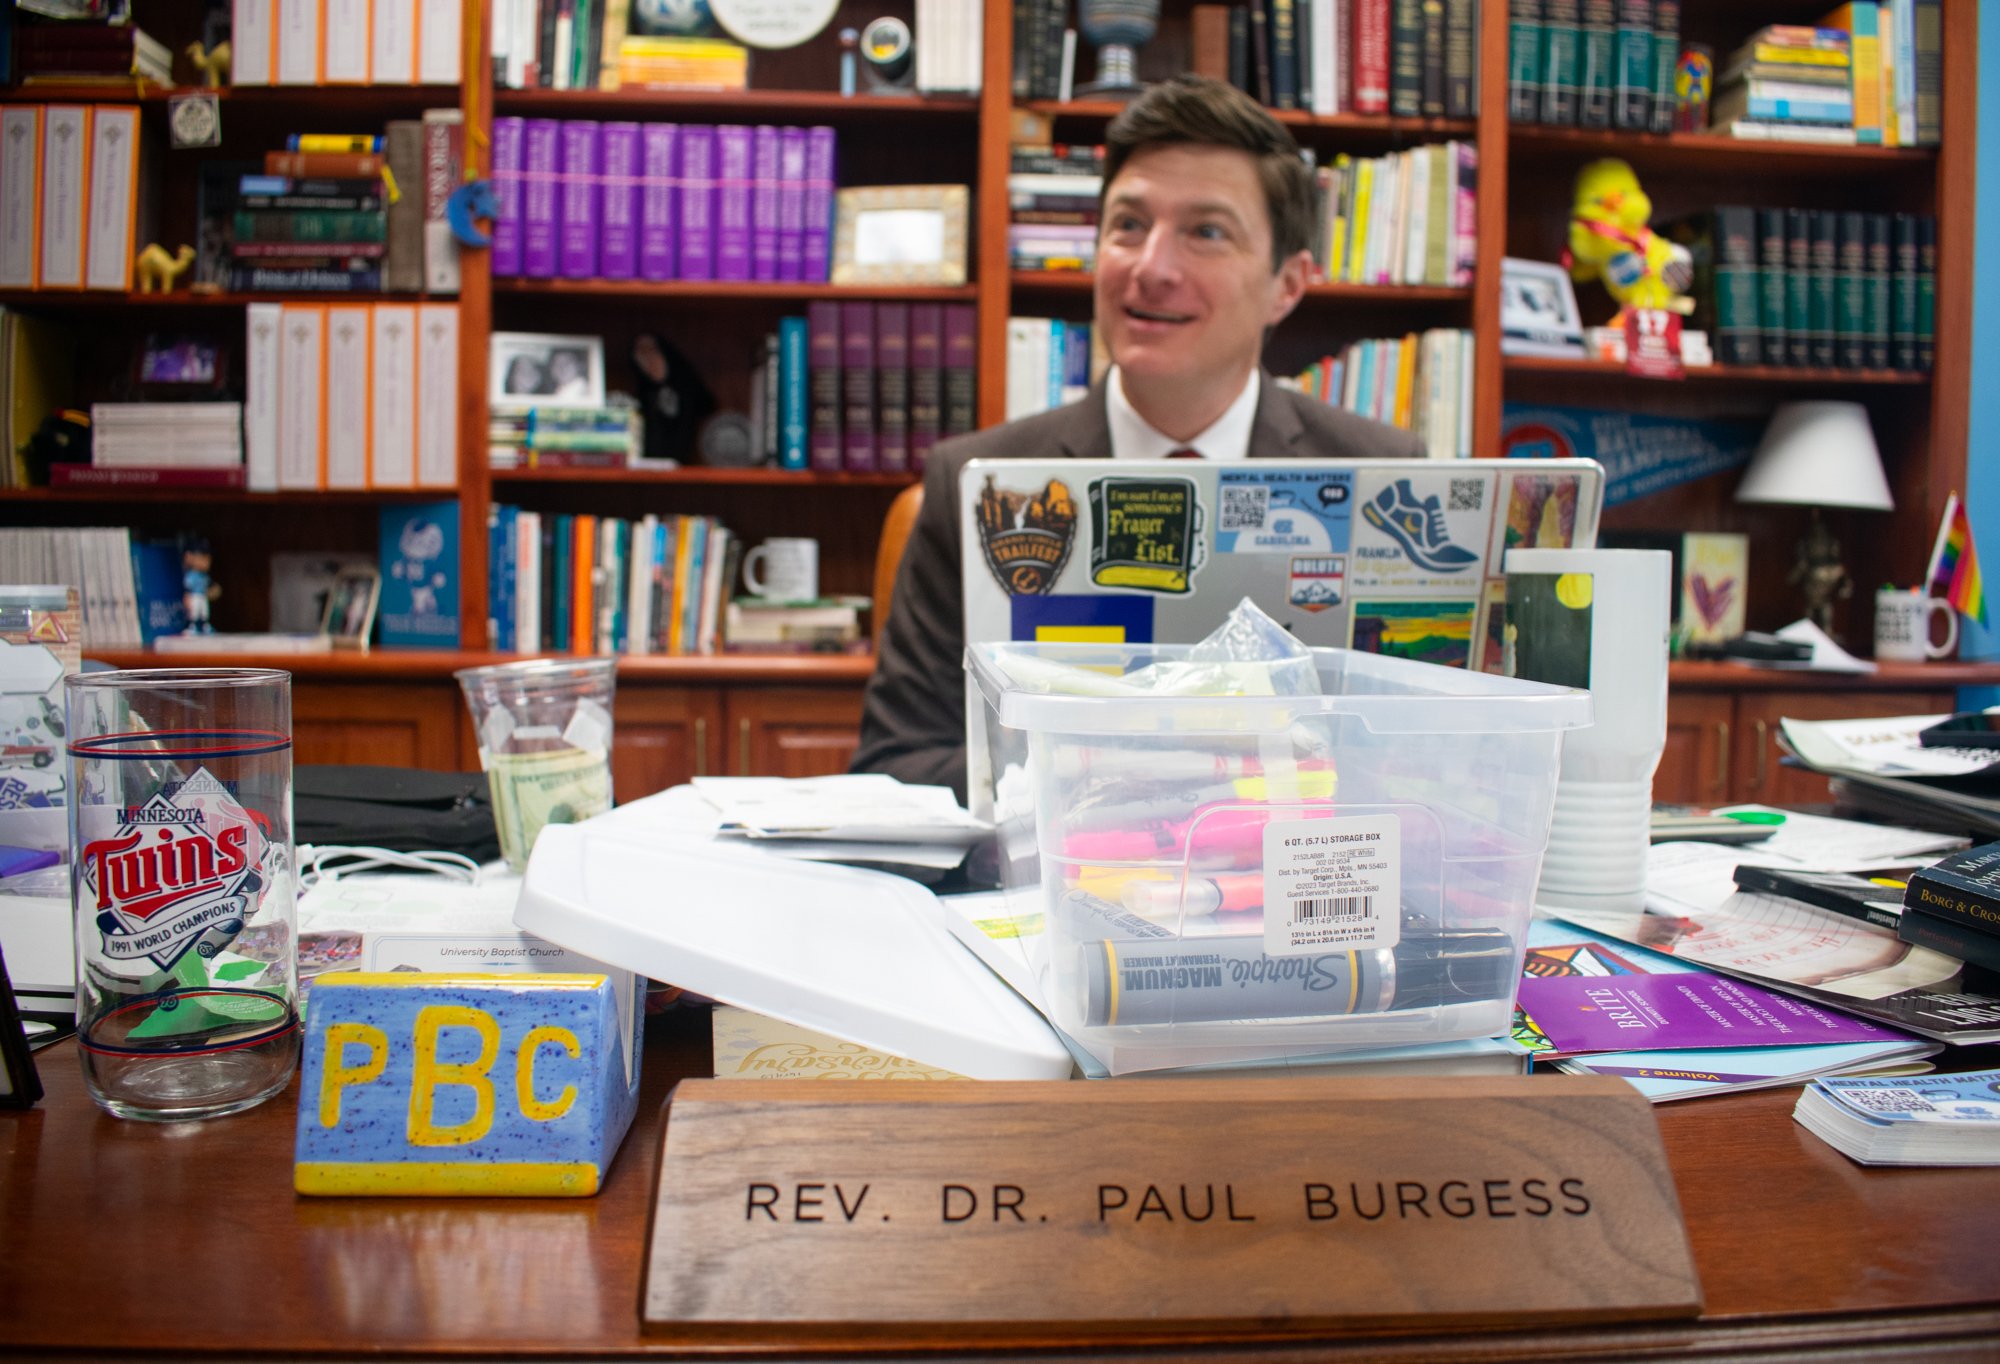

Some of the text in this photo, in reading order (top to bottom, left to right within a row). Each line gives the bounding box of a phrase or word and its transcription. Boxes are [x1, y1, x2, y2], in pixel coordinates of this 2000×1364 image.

[1222, 473, 1351, 481] MENTAL HEALTH MATTERS
[1322, 488, 1344, 496] 988
[1109, 509, 1165, 539] Prayer
[1255, 536, 1311, 545] CAROLINA
[993, 543, 1061, 563] TRAILFEST
[1135, 539, 1180, 563] List.
[1356, 547, 1402, 559] FRANKLIN
[116, 808, 205, 824] MINNESOTA
[1284, 839, 1290, 847] 6
[1291, 838, 1304, 846] QT.
[1305, 837, 1320, 846] (5.7
[1321, 837, 1329, 845] L)
[1330, 834, 1364, 844] STORAGE
[84, 825, 248, 911] Twins
[1292, 868, 1301, 876] by
[1301, 866, 1320, 875] Target
[1313, 873, 1333, 881] Origin:
[1304, 888, 1330, 897] Services
[1331, 885, 1380, 895] 1-800-440-0680
[1318, 880, 1336, 889] Target
[1956, 900, 1966, 913] &
[1303, 917, 1332, 925] 73149
[1334, 915, 1363, 924] 21528
[111, 901, 236, 953] 1991 WORLD CHAMPIONS
[1363, 933, 1375, 941] cm)
[440, 947, 565, 958] University Baptist Church
[1123, 956, 1163, 969] MARKER
[1124, 966, 1223, 992] MAGNUM
[1225, 954, 1347, 992] Sharpie
[1585, 988, 1648, 1029] BRITE
[1675, 985, 1735, 1028] MASTER OF DIVINITY
[1728, 1001, 1744, 1009] OF
[1740, 997, 1762, 1008] AND
[1775, 999, 1805, 1016] MASTER
[1737, 1008, 1767, 1026] MASTER
[1753, 1008, 1793, 1033] THEOLOGY
[319, 1005, 582, 1147] PBC
[1653, 1069, 1721, 1081] Volume
[1825, 1079, 1885, 1088] MENTAL
[1891, 1077, 1951, 1086] HEALTH
[745, 1178, 1591, 1223] REV. DR. PAUL BURGESS
